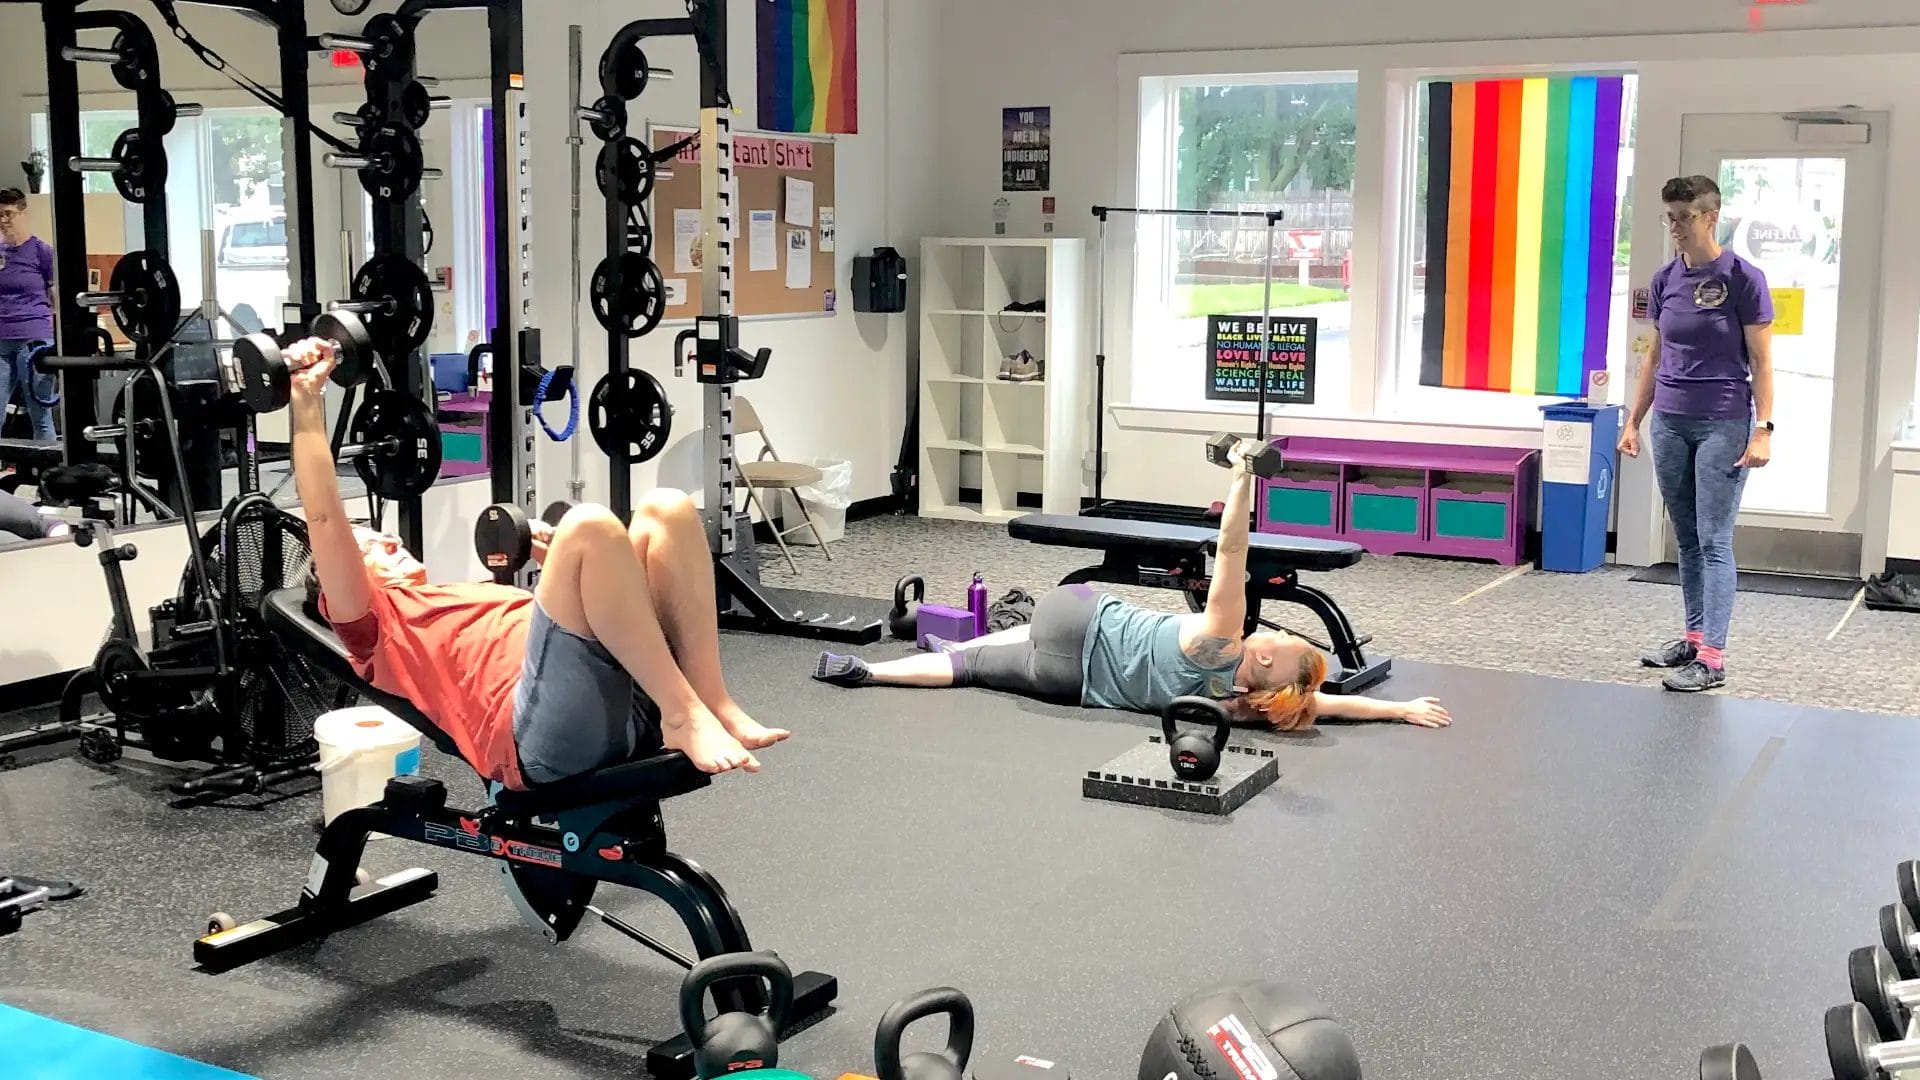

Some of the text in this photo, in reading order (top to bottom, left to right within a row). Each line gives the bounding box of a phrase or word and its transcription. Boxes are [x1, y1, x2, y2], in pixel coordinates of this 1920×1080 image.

[634, 69, 643, 79] 5
[1019, 111, 1034, 123] YOU
[1013, 131, 1029, 143] ARE
[1004, 149, 1048, 162] INDIGENOUS
[638, 160, 648, 174] 10
[1016, 169, 1036, 181] LAND
[379, 186, 391, 198] 10
[359, 274, 372, 295] 25
[1218, 322, 1240, 333] WE
[1217, 333, 1244, 341] BLACK
[1272, 335, 1306, 343] MATTER
[1216, 341, 1230, 349] NO
[1278, 343, 1306, 351] ILLEGAL
[1216, 349, 1249, 360] LOVE
[1272, 352, 1306, 361] LOVE
[1215, 369, 1260, 379] SCIENCE
[1279, 371, 1304, 380] REAL
[1215, 378, 1255, 387] WATER
[1279, 380, 1305, 389] LIFE
[640, 431, 656, 450] 35
[417, 437, 428, 459] 35
